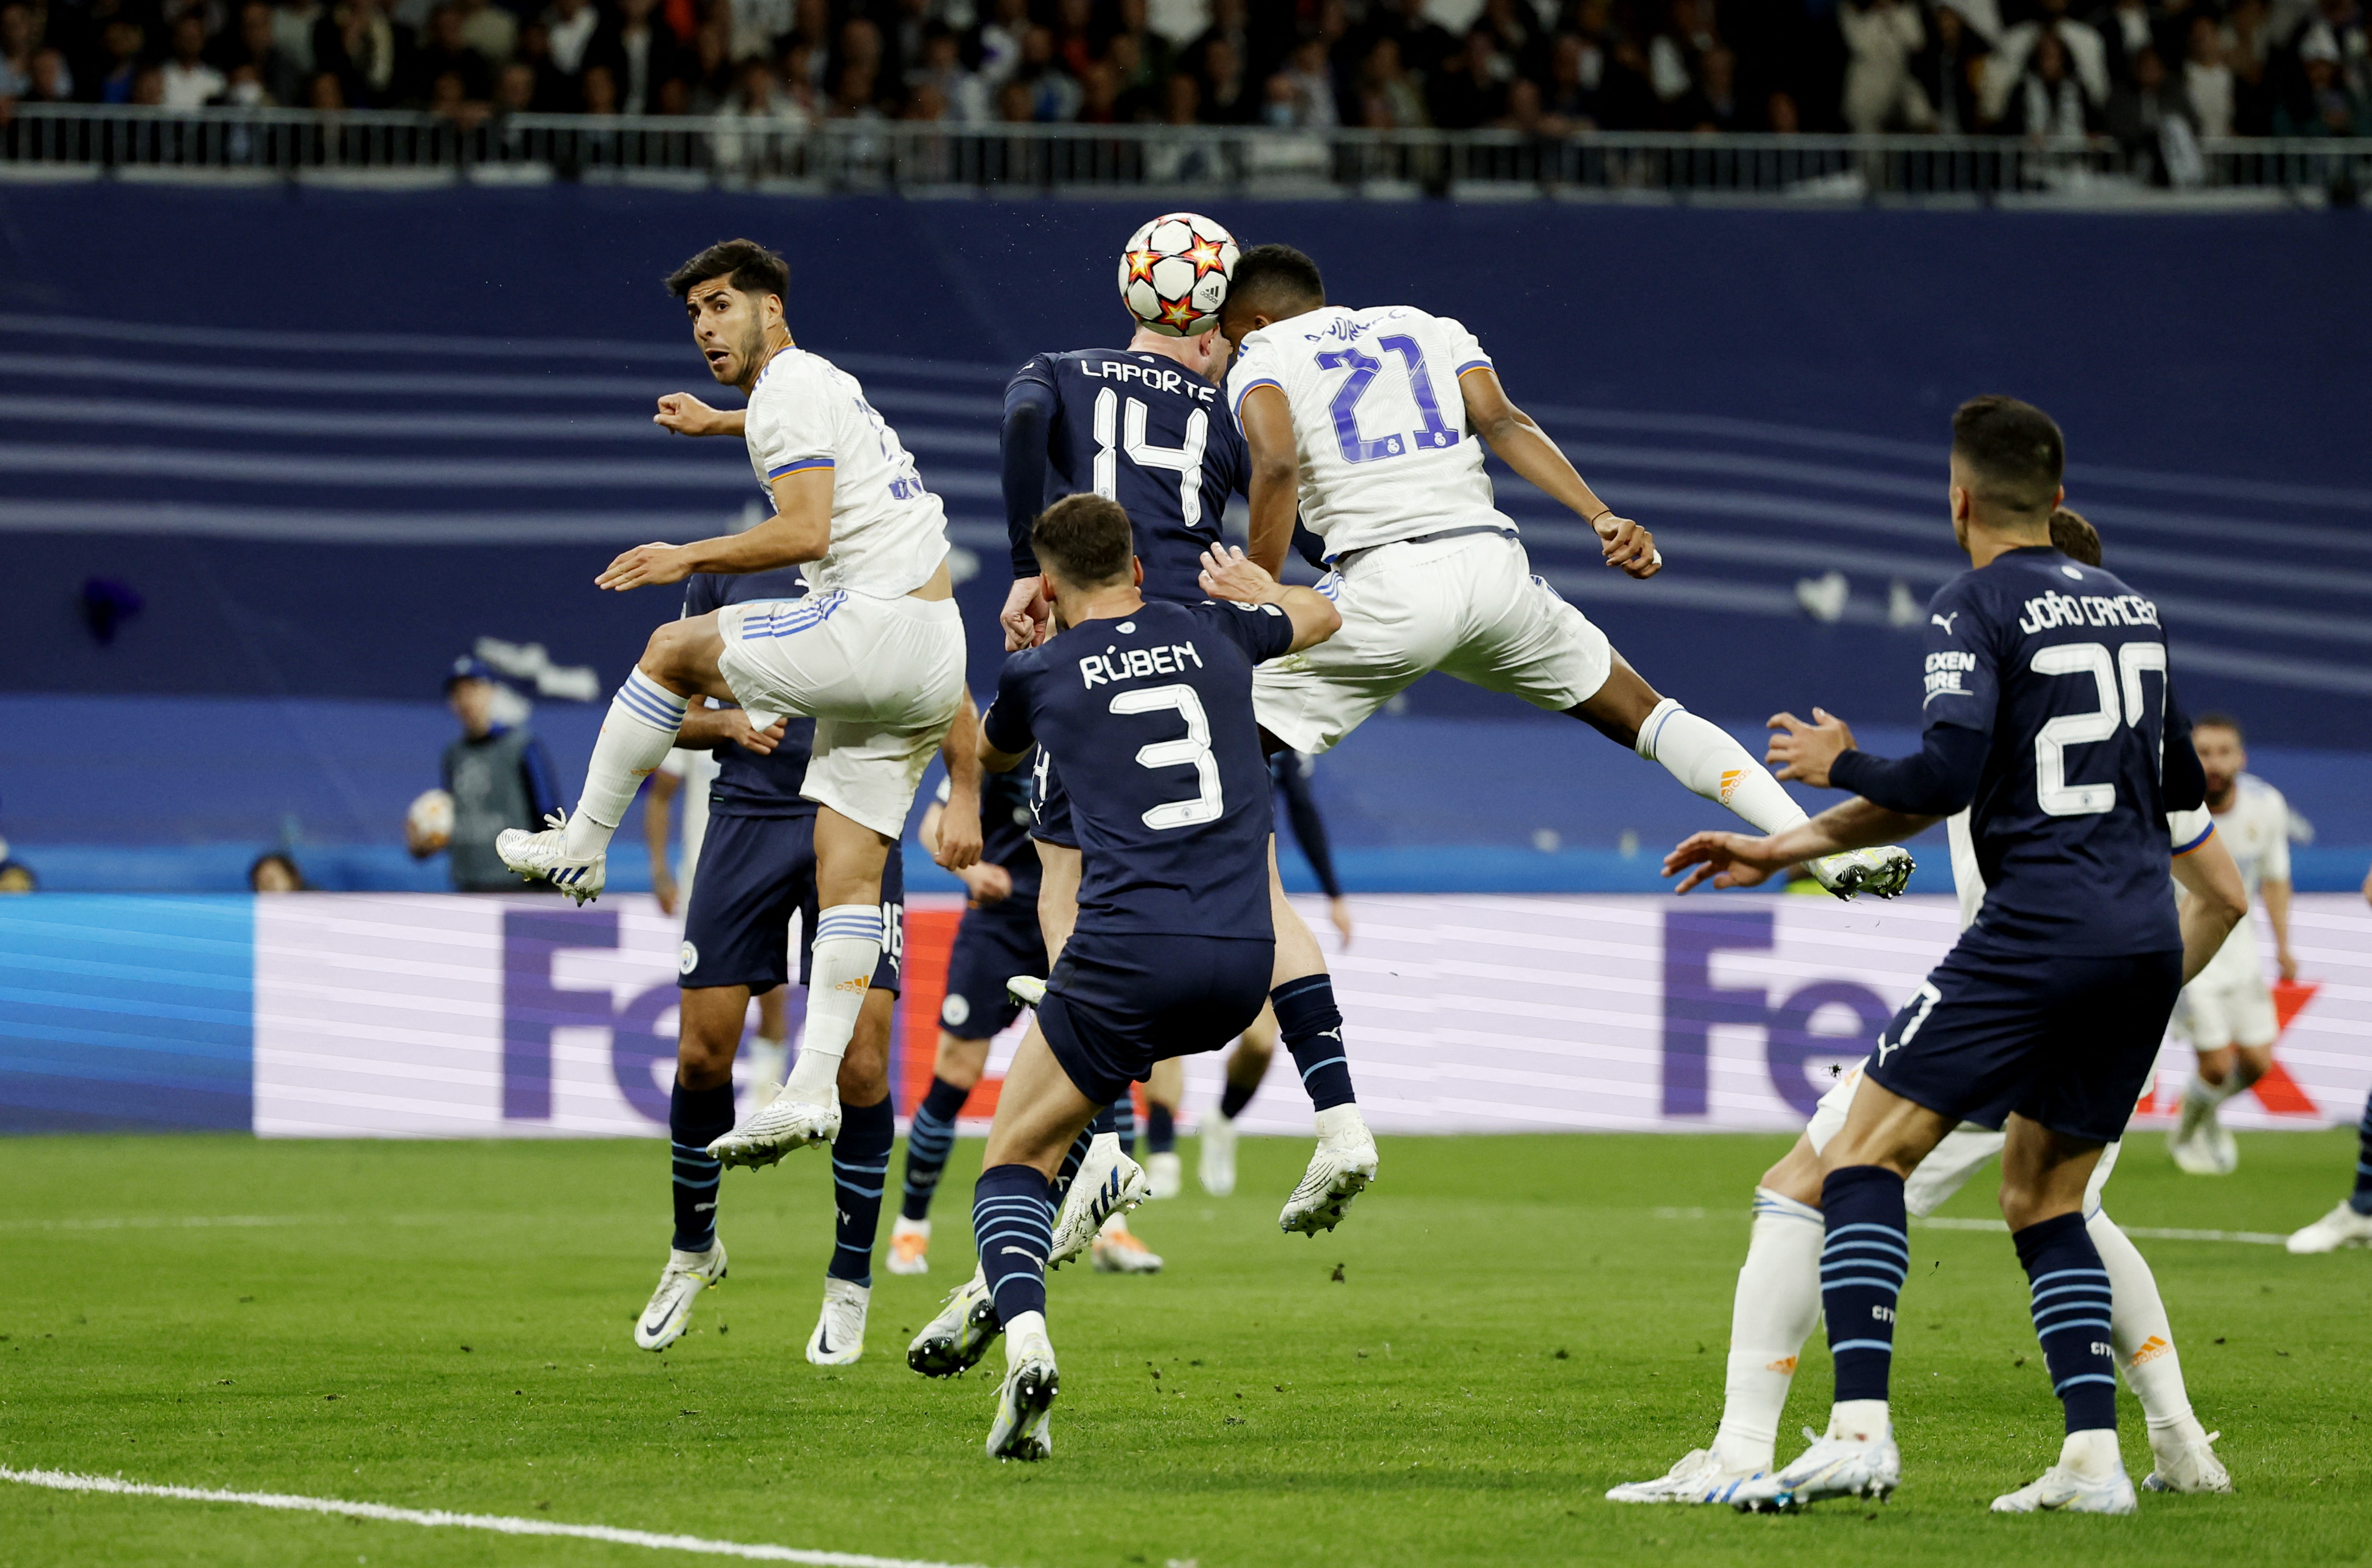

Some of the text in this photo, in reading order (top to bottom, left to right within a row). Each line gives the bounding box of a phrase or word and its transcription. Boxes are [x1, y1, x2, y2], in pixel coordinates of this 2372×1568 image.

[1200, 290, 1219, 305] adidas
[1081, 360, 1217, 412] LAPORTE
[1314, 333, 1460, 464] 21
[1093, 387, 1208, 527] 14
[1079, 641, 1203, 690] RÚBEN
[1923, 670, 1962, 694] TIRE
[1925, 650, 1976, 674] EXEN
[1109, 684, 1224, 830] 3
